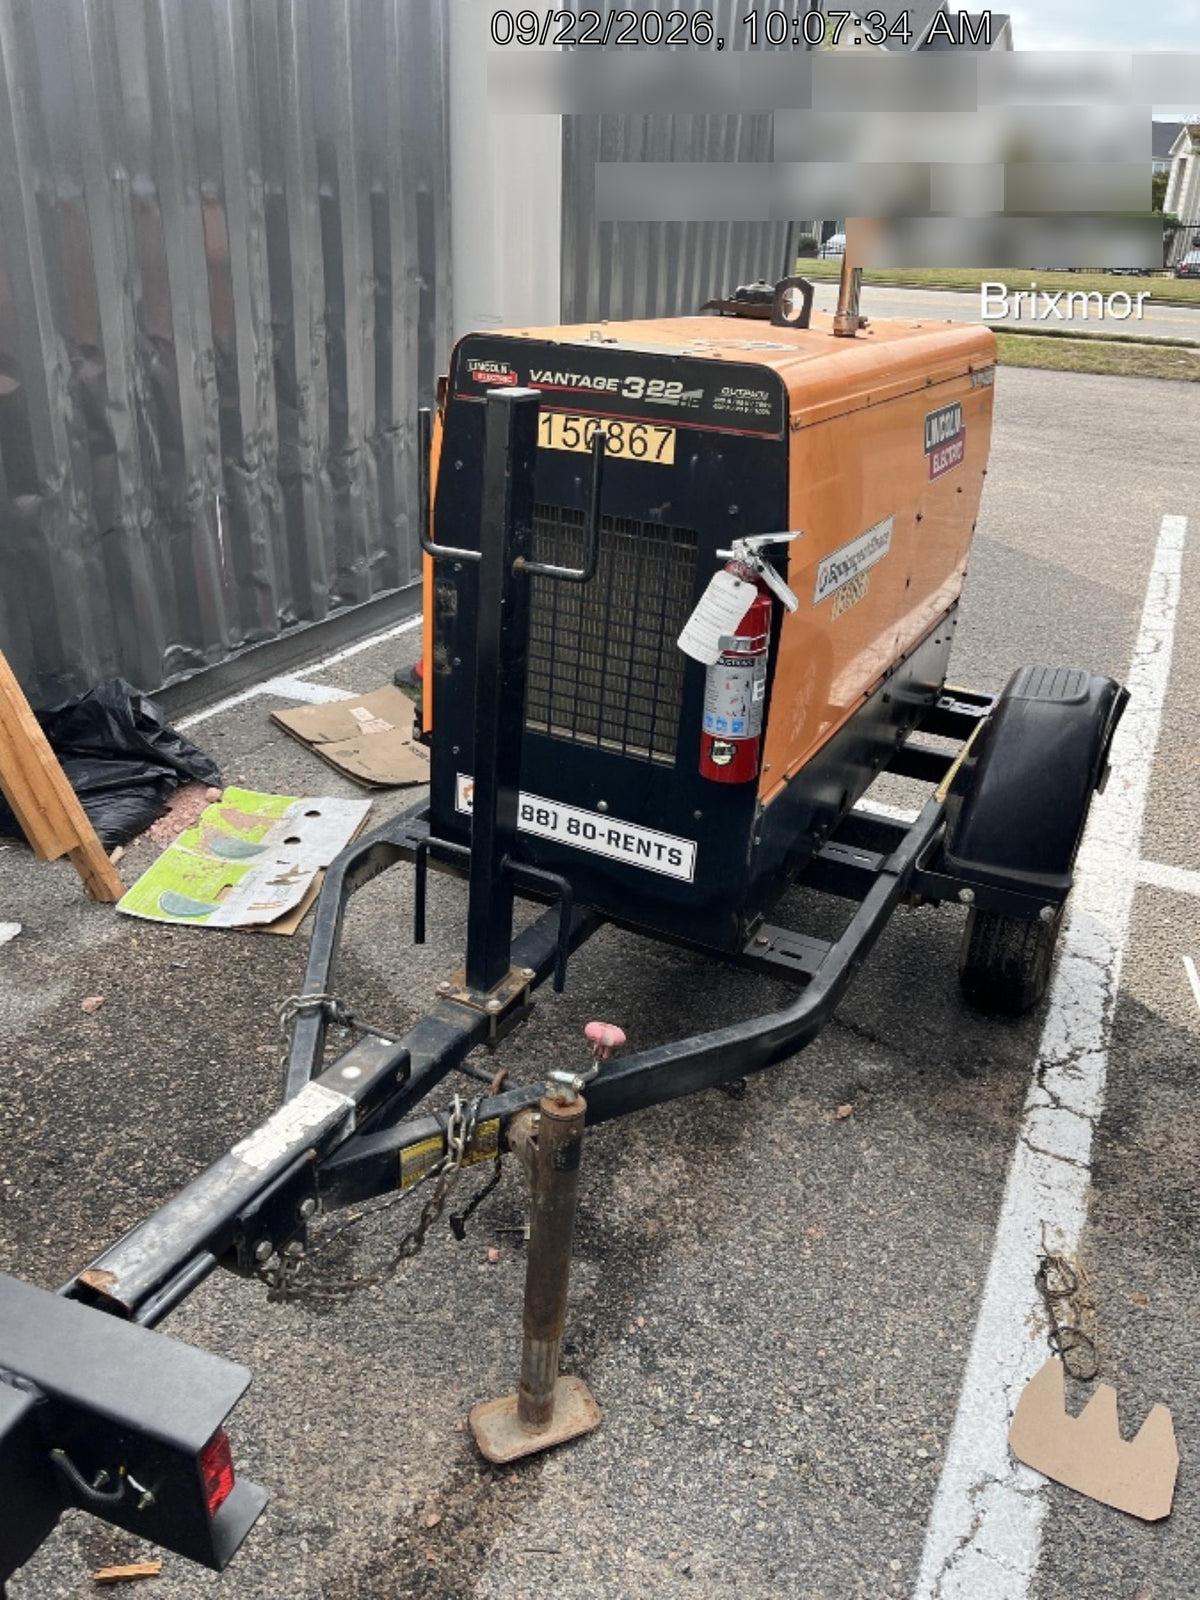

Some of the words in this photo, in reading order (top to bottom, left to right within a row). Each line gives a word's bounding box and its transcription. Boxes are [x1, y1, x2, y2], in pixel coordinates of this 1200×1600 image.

[528, 369, 620, 391] VANTAGE
[622, 375, 684, 399] 322
[925, 407, 961, 449] LINCOLN
[521, 804, 558, 830] 88)
[566, 818, 683, 867] 80-RENTS
